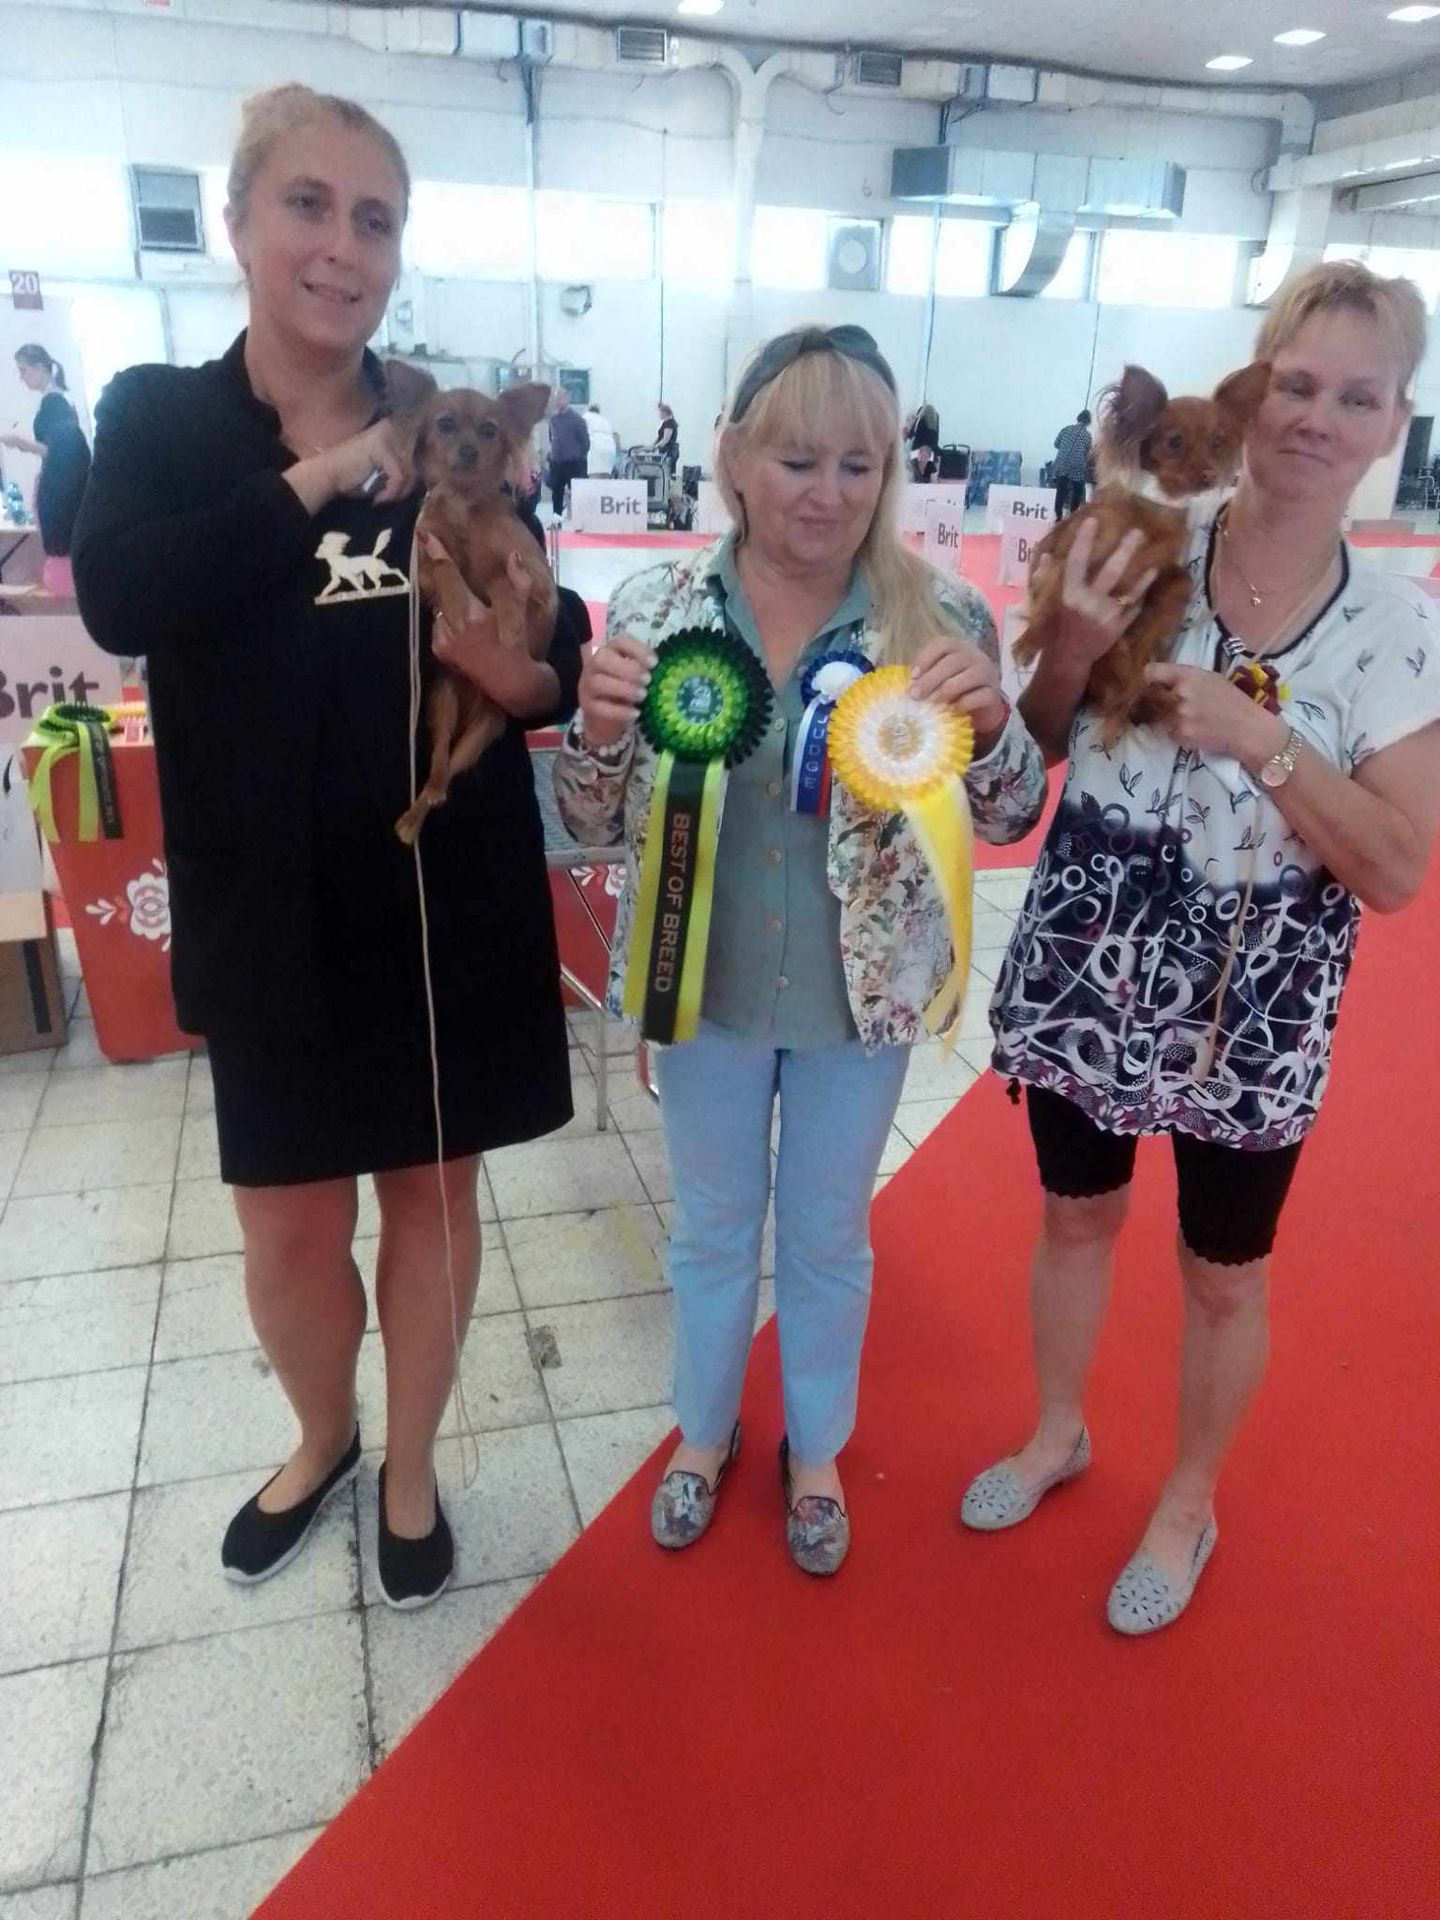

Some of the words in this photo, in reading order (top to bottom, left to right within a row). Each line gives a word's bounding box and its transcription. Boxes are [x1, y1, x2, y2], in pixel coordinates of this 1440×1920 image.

[11, 271, 38, 294] 20
[600, 496, 641, 515] Brit
[1012, 501, 1048, 520] Brit
[937, 522, 959, 549] Brit
[804, 715, 828, 789] JUDGE
[670, 812, 690, 873] BEST
[665, 876, 684, 908] OF
[654, 914, 680, 993] BREED
